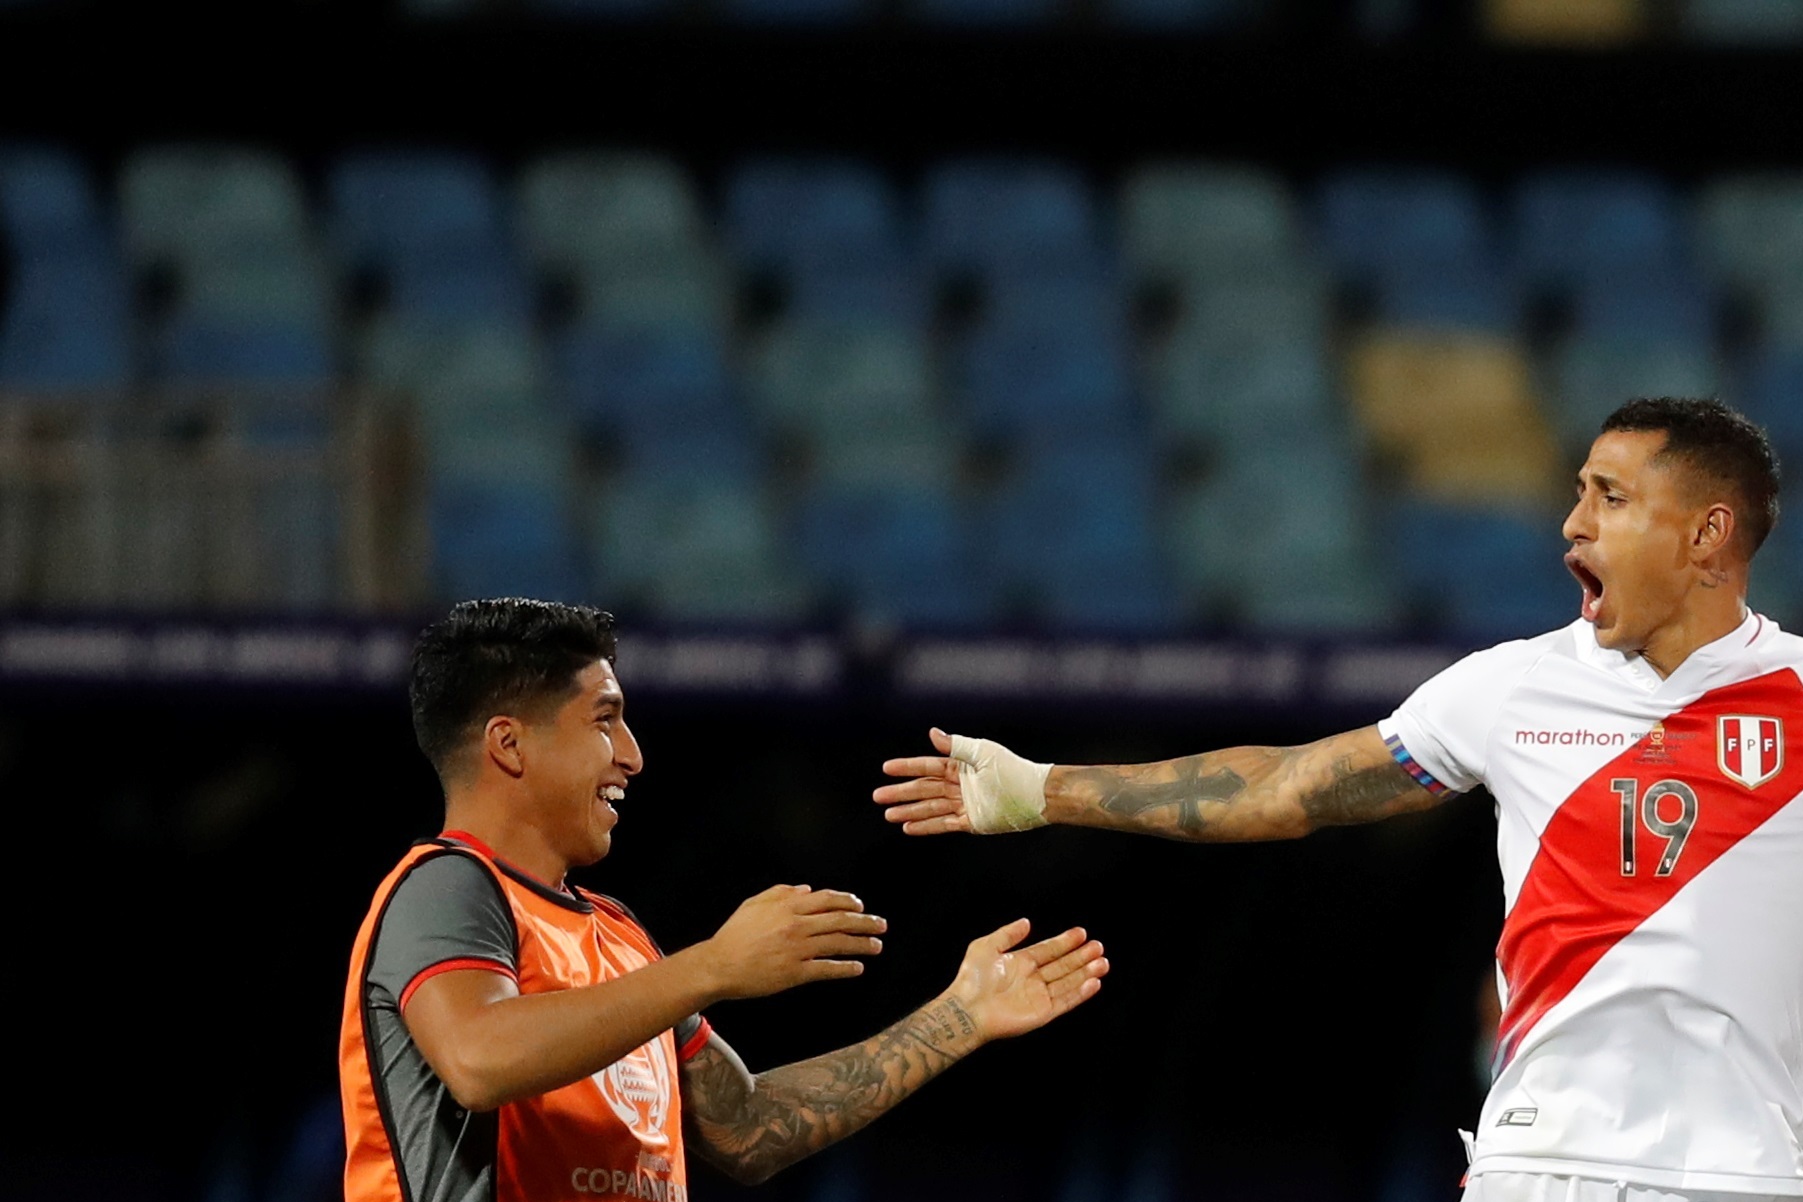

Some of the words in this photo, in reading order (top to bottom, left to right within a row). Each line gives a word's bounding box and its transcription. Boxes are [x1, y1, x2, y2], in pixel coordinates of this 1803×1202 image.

[1515, 729, 1625, 747] marathon
[1610, 778, 1698, 877] 19
[571, 1166, 637, 1198] COPA
